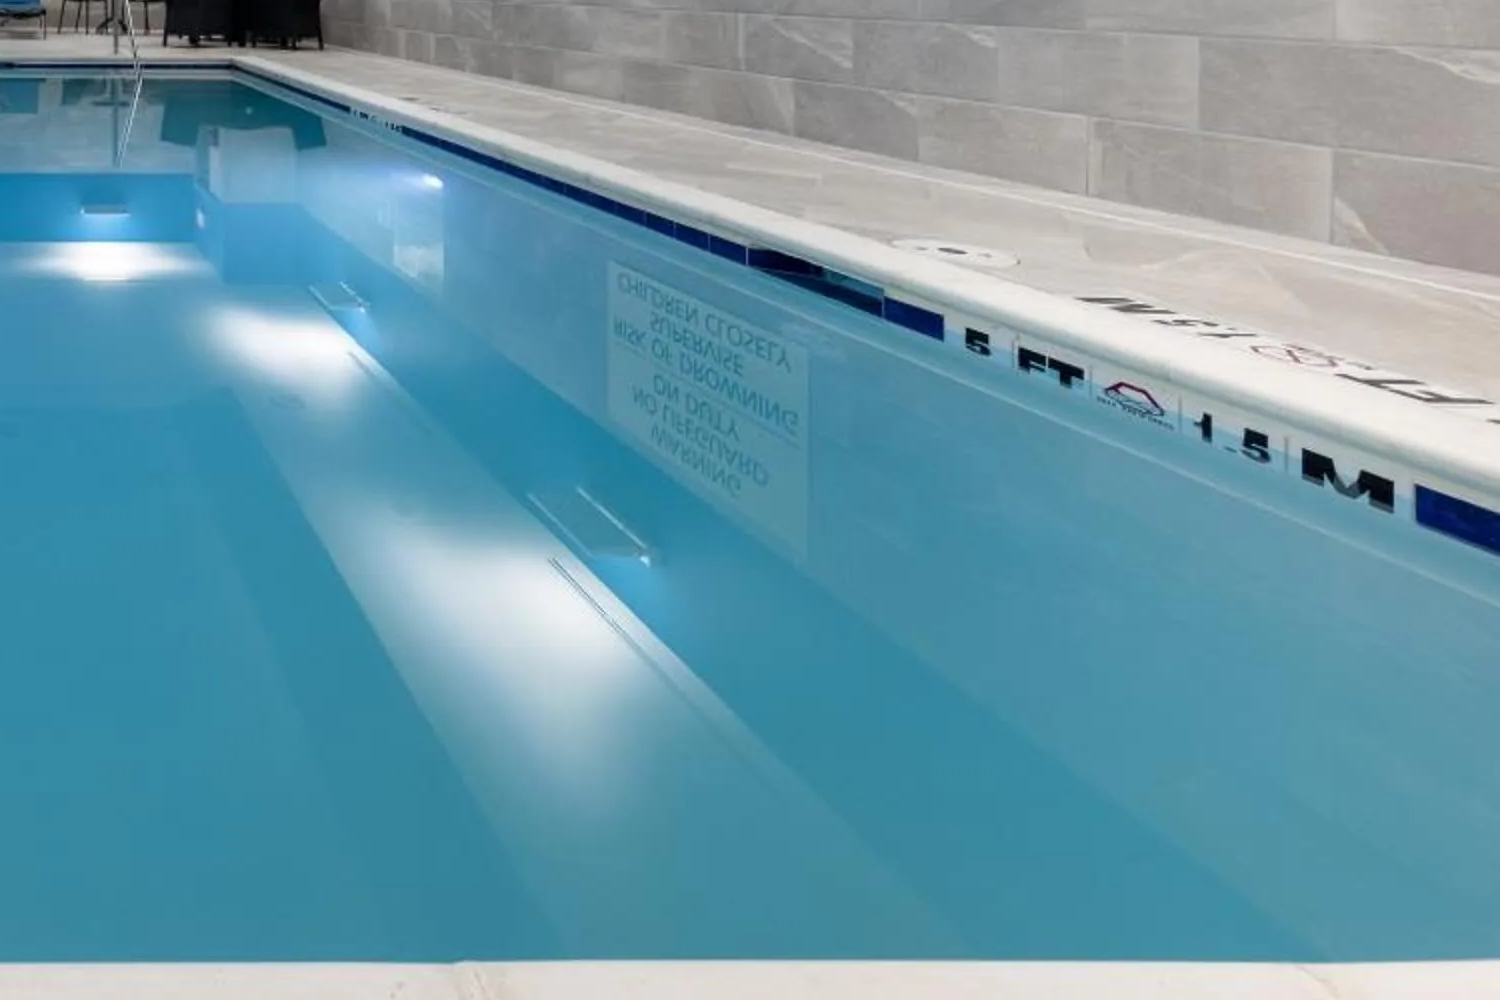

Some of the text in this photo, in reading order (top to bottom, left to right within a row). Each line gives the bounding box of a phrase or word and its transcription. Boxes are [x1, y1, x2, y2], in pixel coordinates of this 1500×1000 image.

[965, 327, 991, 357] 5
[1017, 346, 1085, 389] FT
[1301, 447, 1395, 515] M
